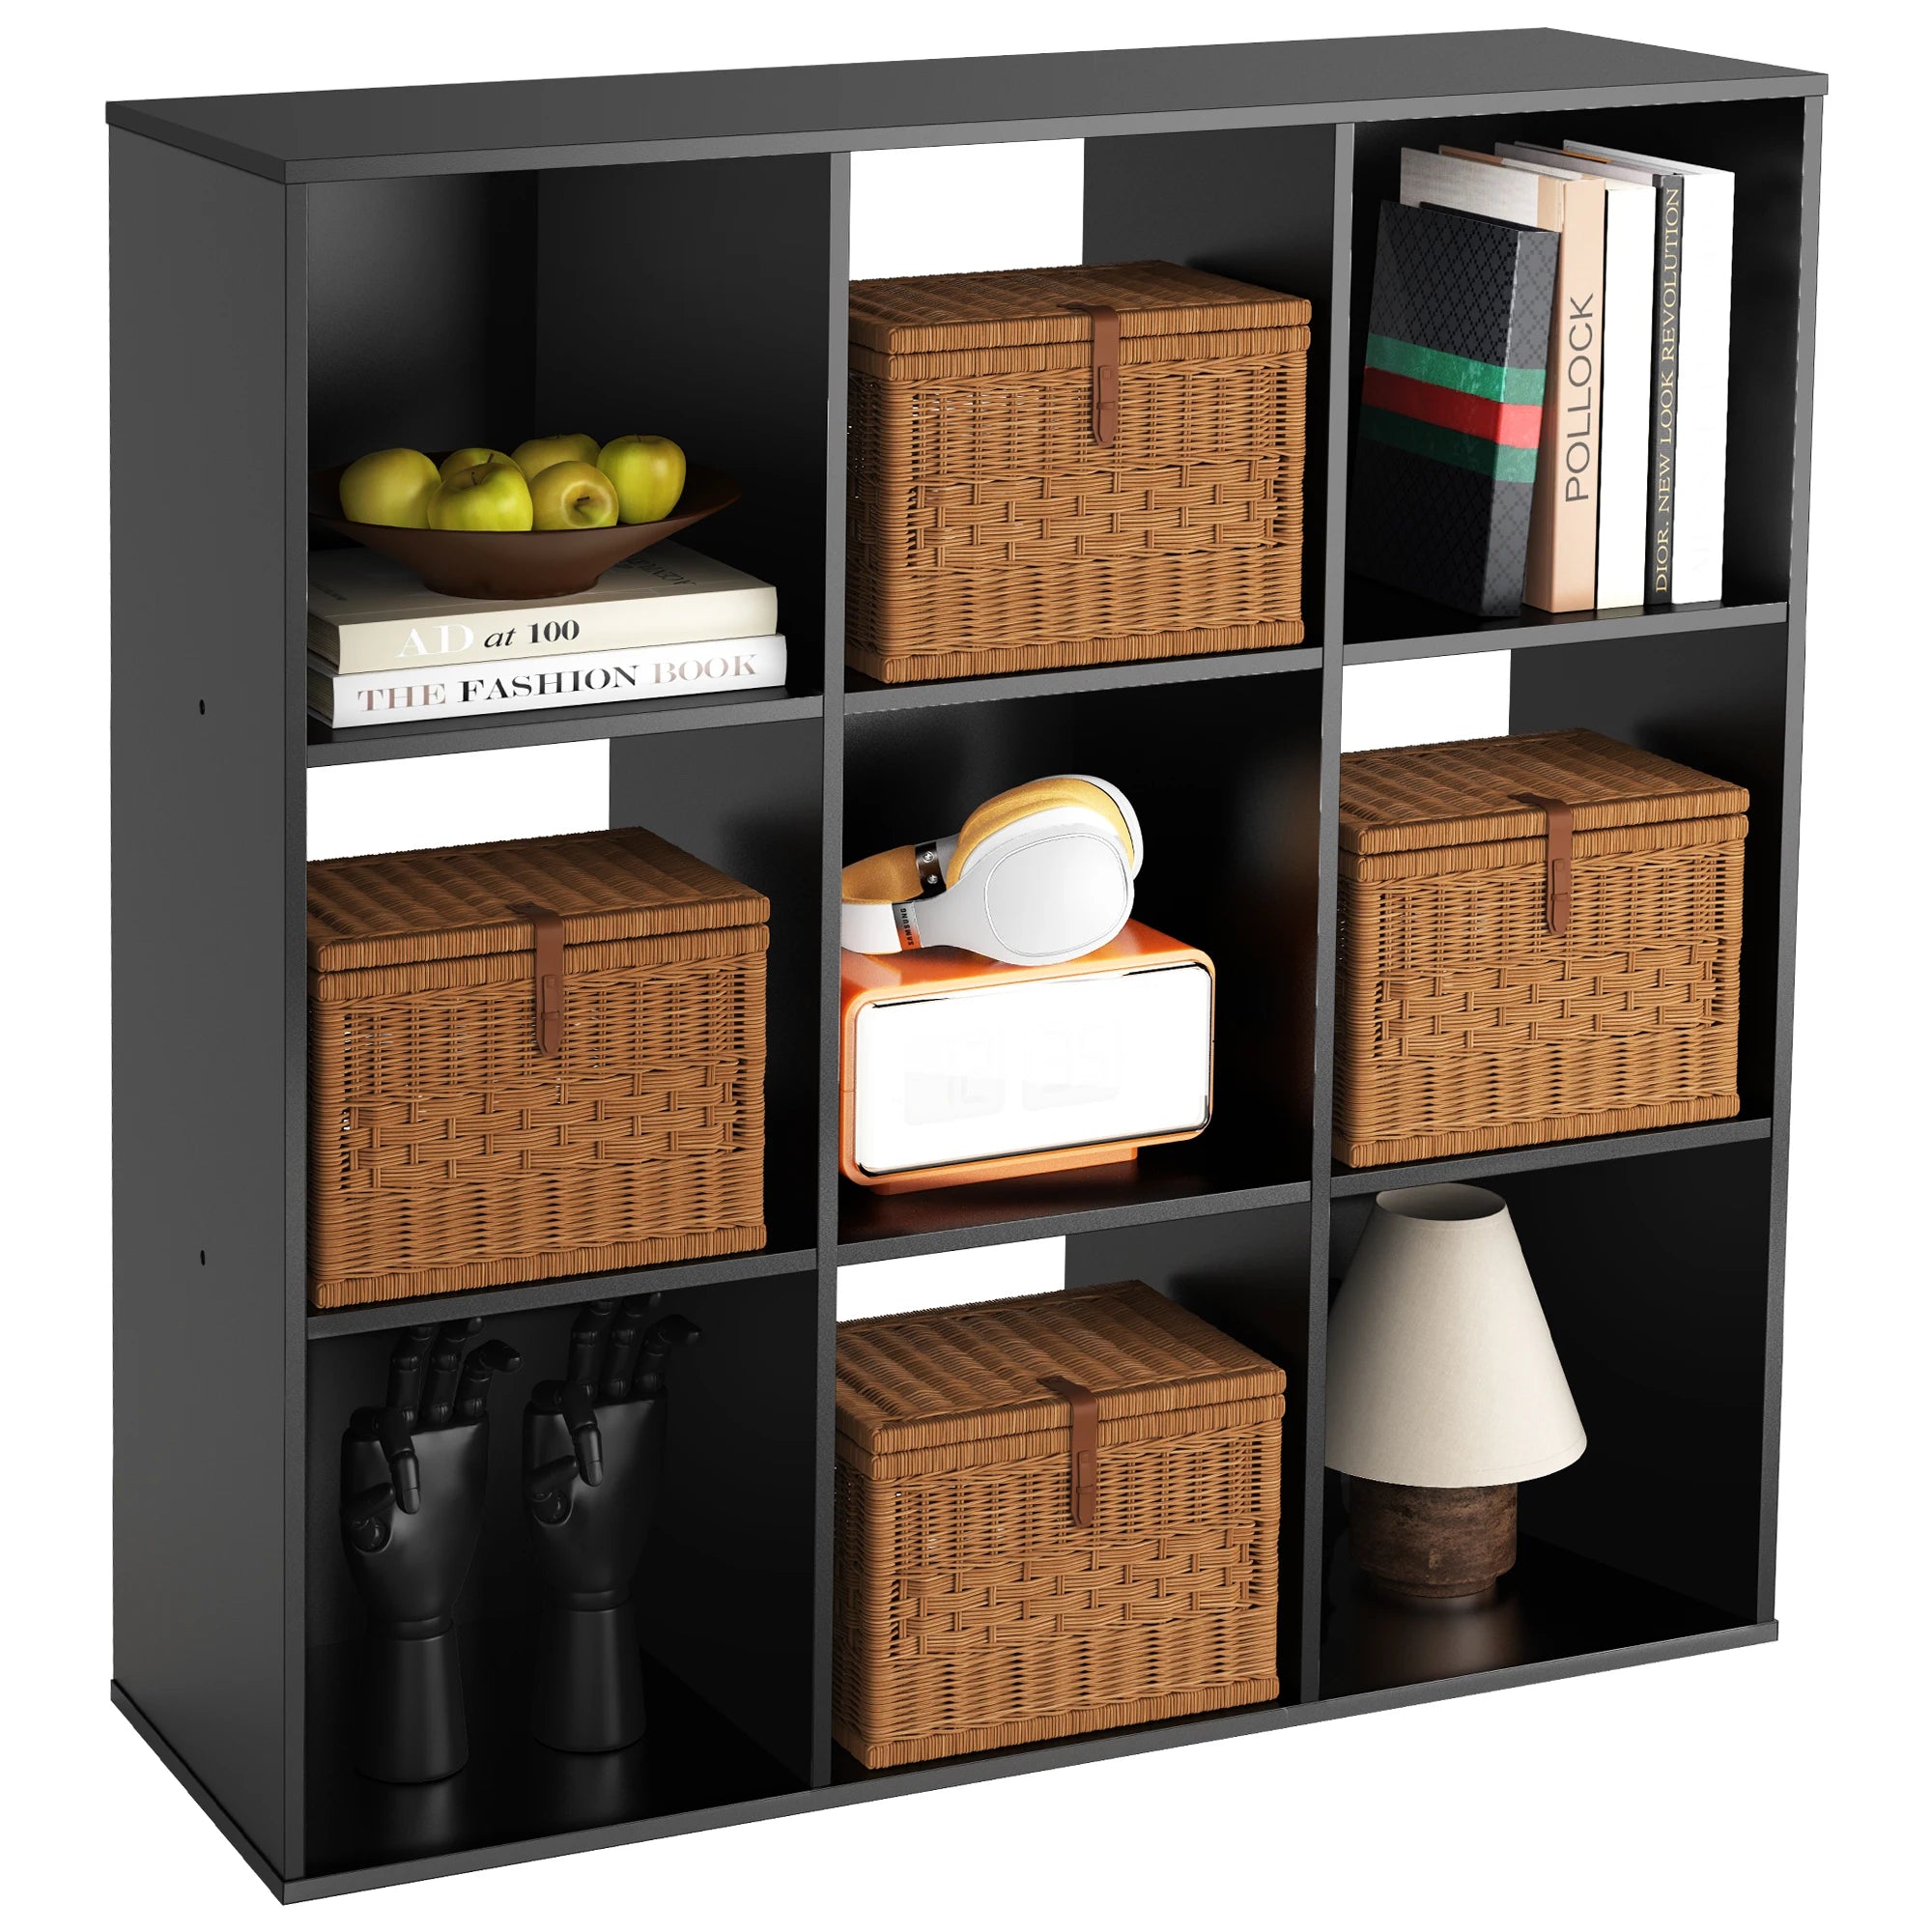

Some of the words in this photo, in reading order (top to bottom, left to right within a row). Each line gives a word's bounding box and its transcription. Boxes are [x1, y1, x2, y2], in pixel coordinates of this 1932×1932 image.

[1662, 188, 1679, 361] REVOLUTION
[1565, 294, 1594, 502] POLLOCK
[1661, 370, 1674, 443] LOOK
[1659, 454, 1670, 513] NEW
[1656, 522, 1669, 592] DIOR.
[397, 623, 474, 658] AD
[483, 627, 516, 648] at
[527, 619, 580, 643] 100
[357, 683, 446, 712] THE
[457, 665, 638, 703] FASHION
[653, 653, 757, 684] BOOK
[900, 907, 915, 946] SAMSUNG
